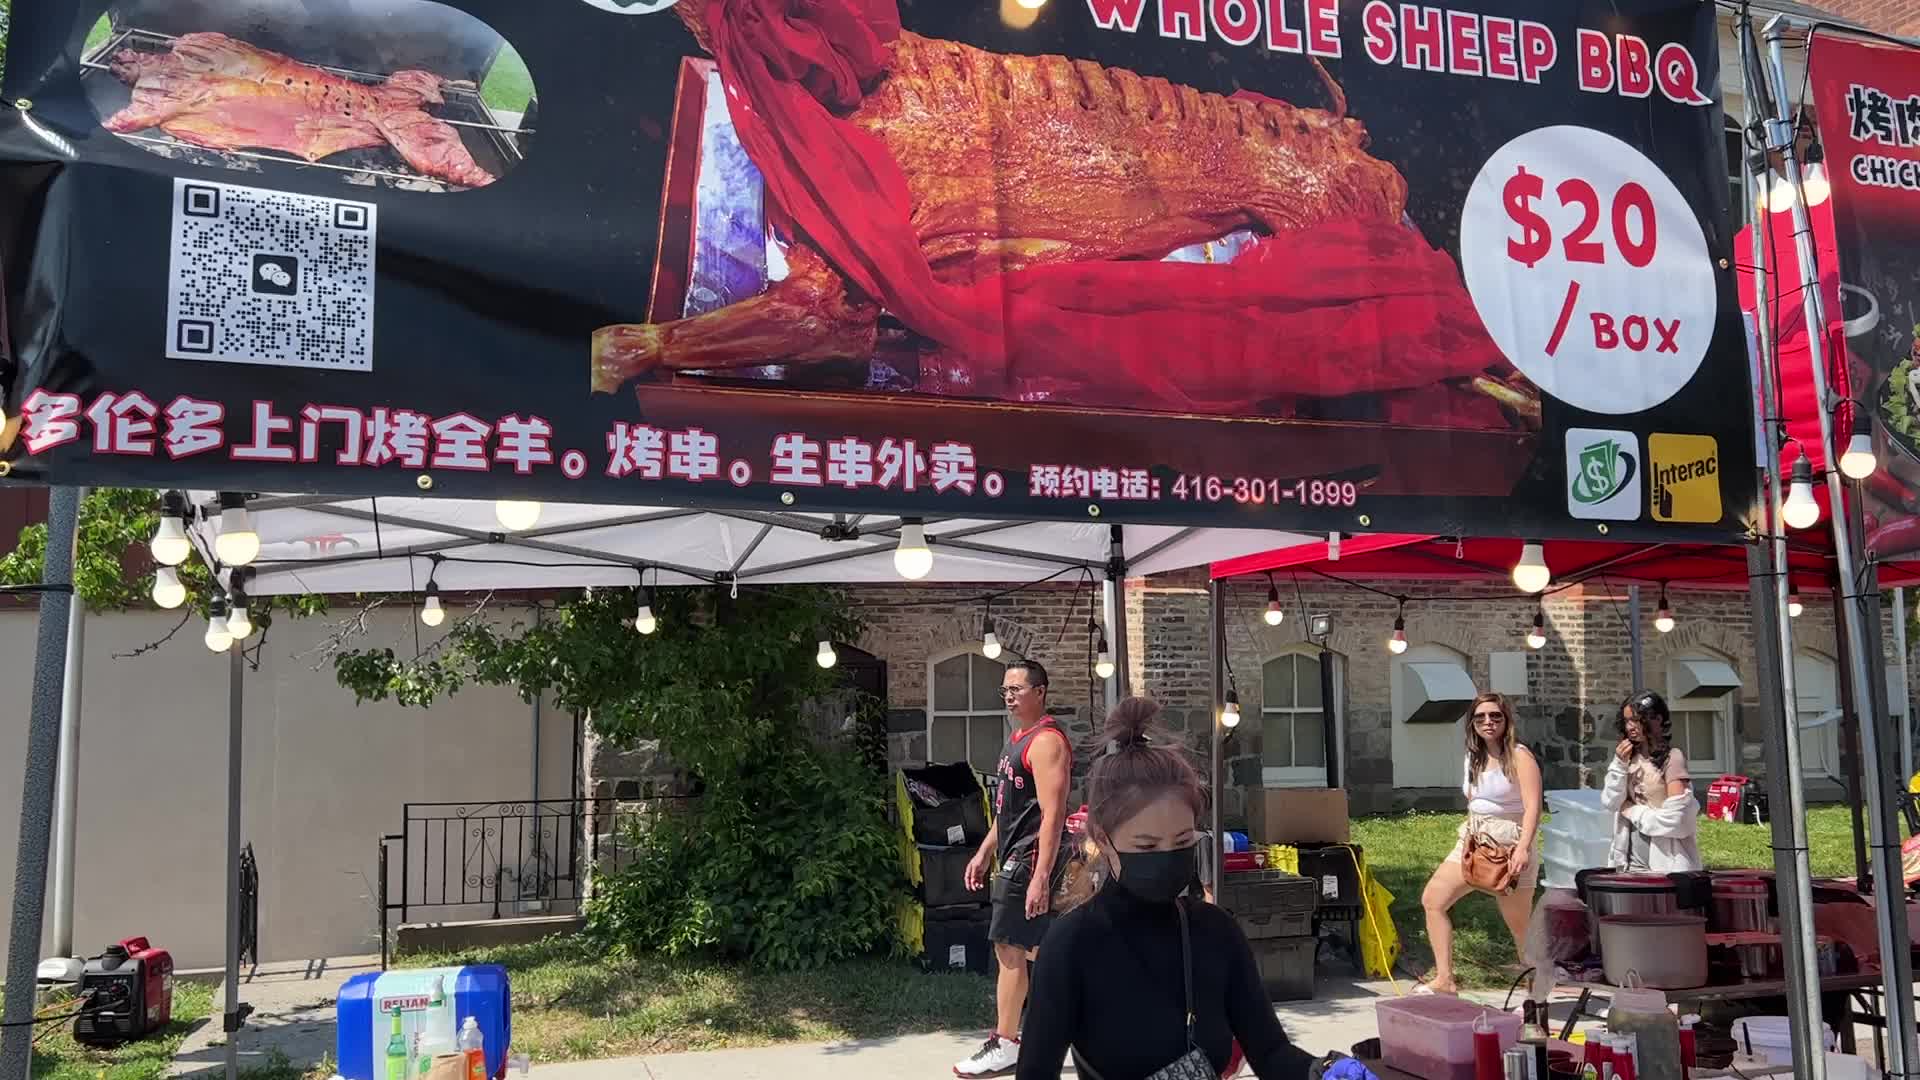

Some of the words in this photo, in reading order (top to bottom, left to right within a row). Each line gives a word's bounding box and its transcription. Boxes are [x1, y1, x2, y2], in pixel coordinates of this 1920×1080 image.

[1087, 0, 1342, 58] WHOLE
[1362, 0, 1557, 84] SHEEP
[1576, 28, 1714, 106] BBQ
[1502, 165, 1657, 269] $20
[1653, 456, 1716, 488] Interac
[1171, 473, 1356, 505] 416-301-1899
[383, 998, 436, 1010] RELIAN
